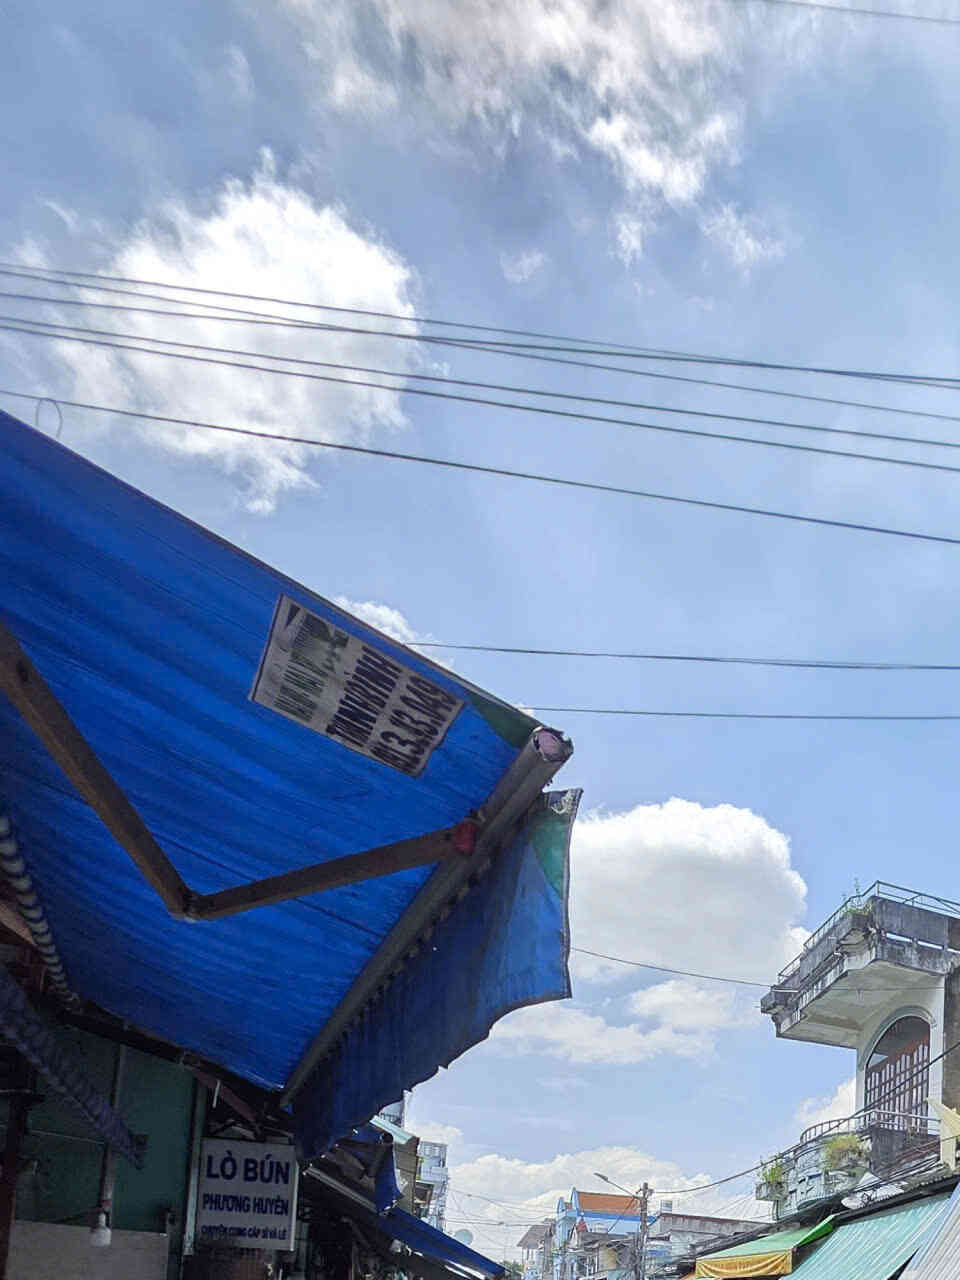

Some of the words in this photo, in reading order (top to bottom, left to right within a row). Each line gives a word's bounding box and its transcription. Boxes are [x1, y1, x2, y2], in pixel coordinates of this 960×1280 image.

[206, 1150, 237, 1181] LÒ
[243, 1154, 290, 1185] BÚN
[203, 1192, 250, 1214] PHƯƠNG
